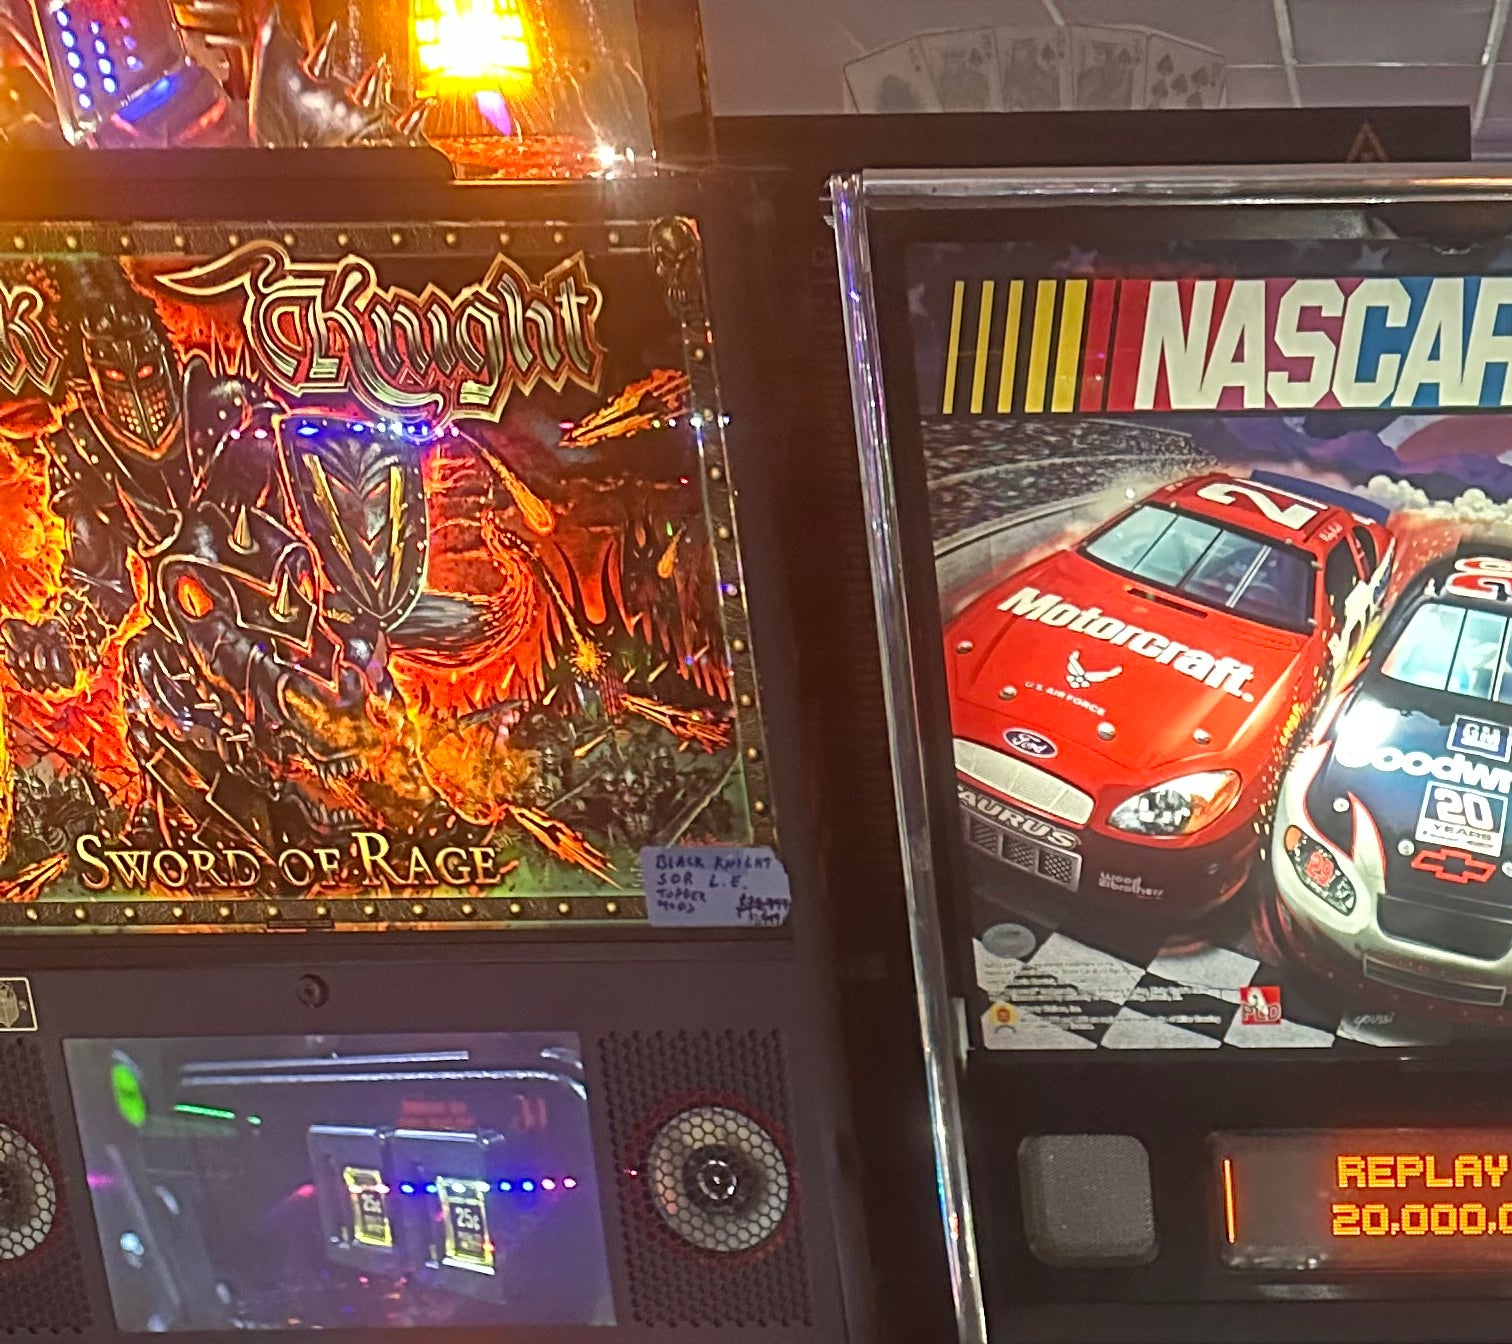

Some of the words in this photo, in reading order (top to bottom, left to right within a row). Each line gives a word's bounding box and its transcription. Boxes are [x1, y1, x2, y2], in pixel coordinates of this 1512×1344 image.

[157, 240, 606, 422] Knight
[1046, 686, 1066, 700] AIR
[1066, 693, 1107, 717] FORCE
[1011, 733, 1048, 755] Ford
[1433, 788, 1495, 830] 20
[1432, 824, 1494, 841] YEARS
[656, 854, 705, 870] BLACK
[714, 855, 772, 870] KNIGHT
[657, 871, 693, 886] SOR
[656, 888, 707, 904] TOPPER
[1337, 1154, 1509, 1188] REPLAY
